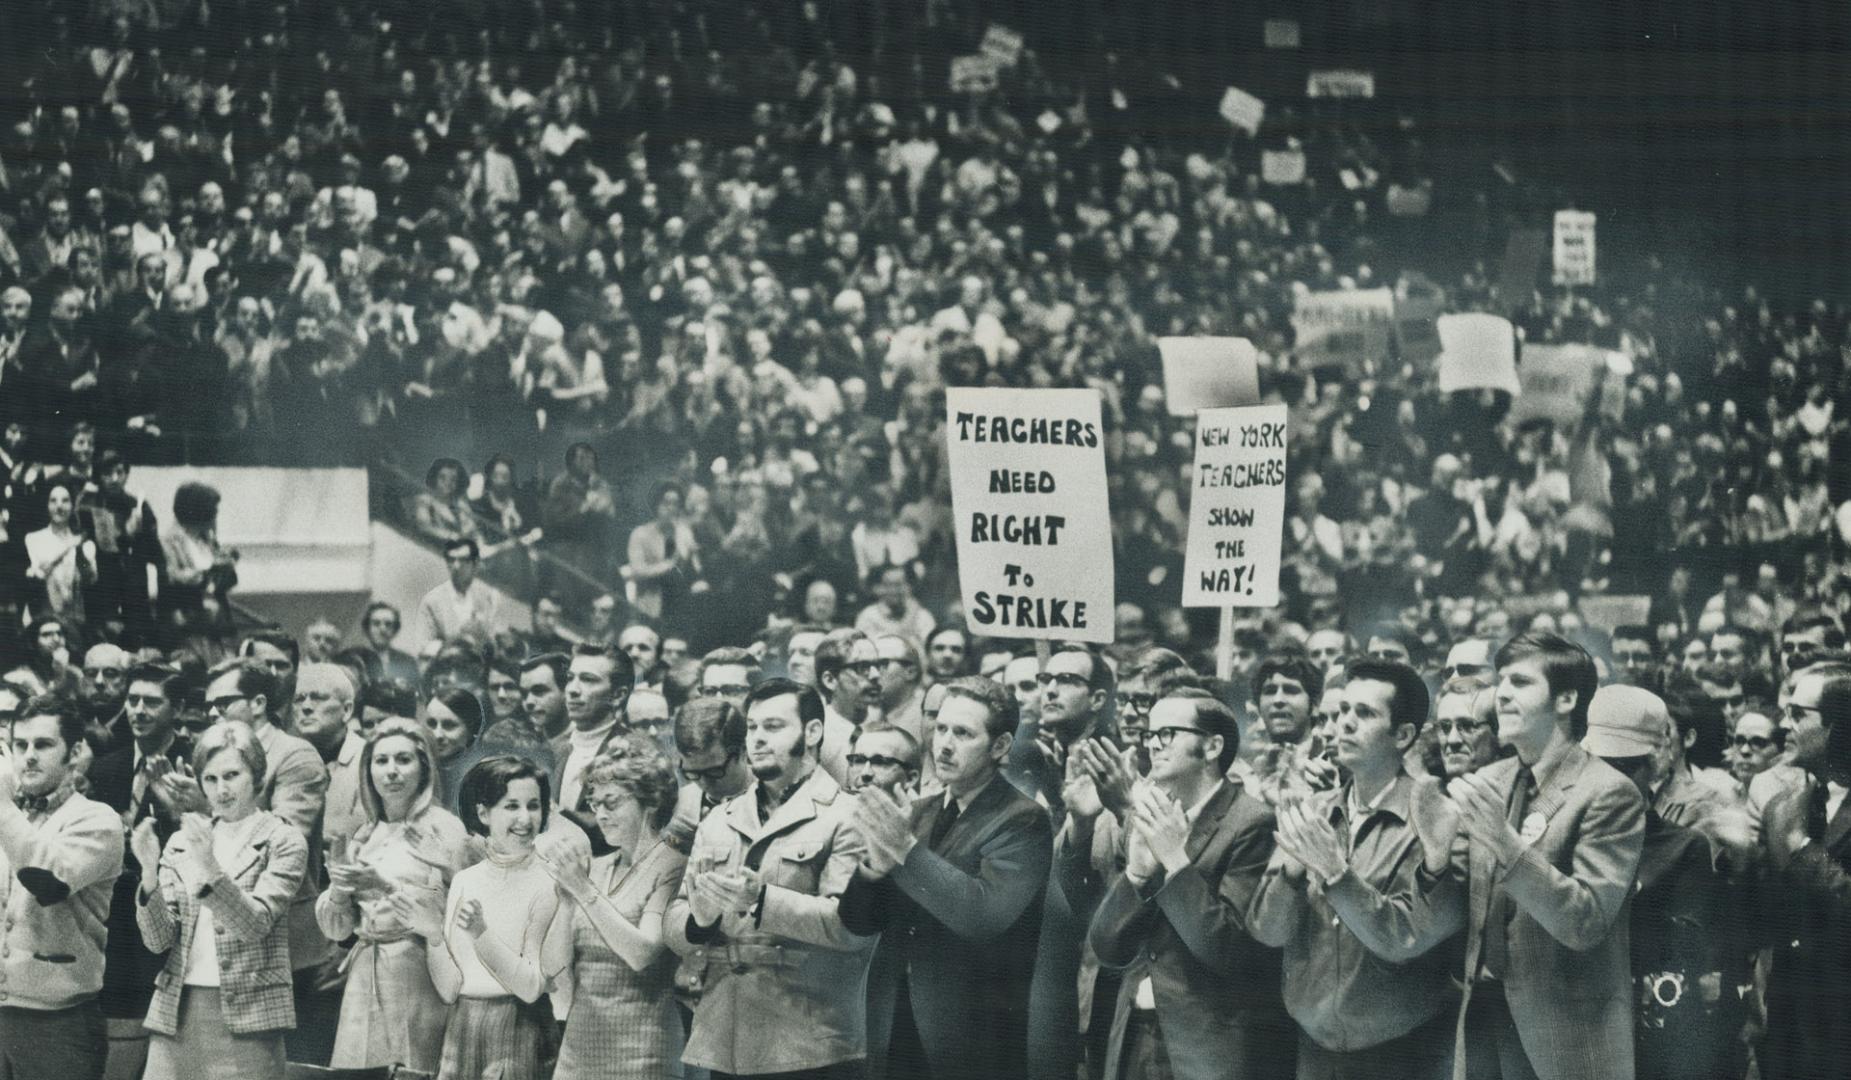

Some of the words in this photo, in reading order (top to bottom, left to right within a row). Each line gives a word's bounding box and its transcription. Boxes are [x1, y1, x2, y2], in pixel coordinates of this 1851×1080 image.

[956, 412, 1098, 448] TEACHERS
[1202, 427, 1229, 447] NEW
[1240, 423, 1286, 448] YORK
[989, 469, 1056, 493] NEED
[1200, 459, 1285, 488] TEACHERS
[971, 512, 1066, 545] RIGHT
[1208, 508, 1254, 527] SHOW
[1215, 540, 1245, 559] THE
[1201, 564, 1255, 596] WAY!
[972, 591, 1087, 629] STRIKE
